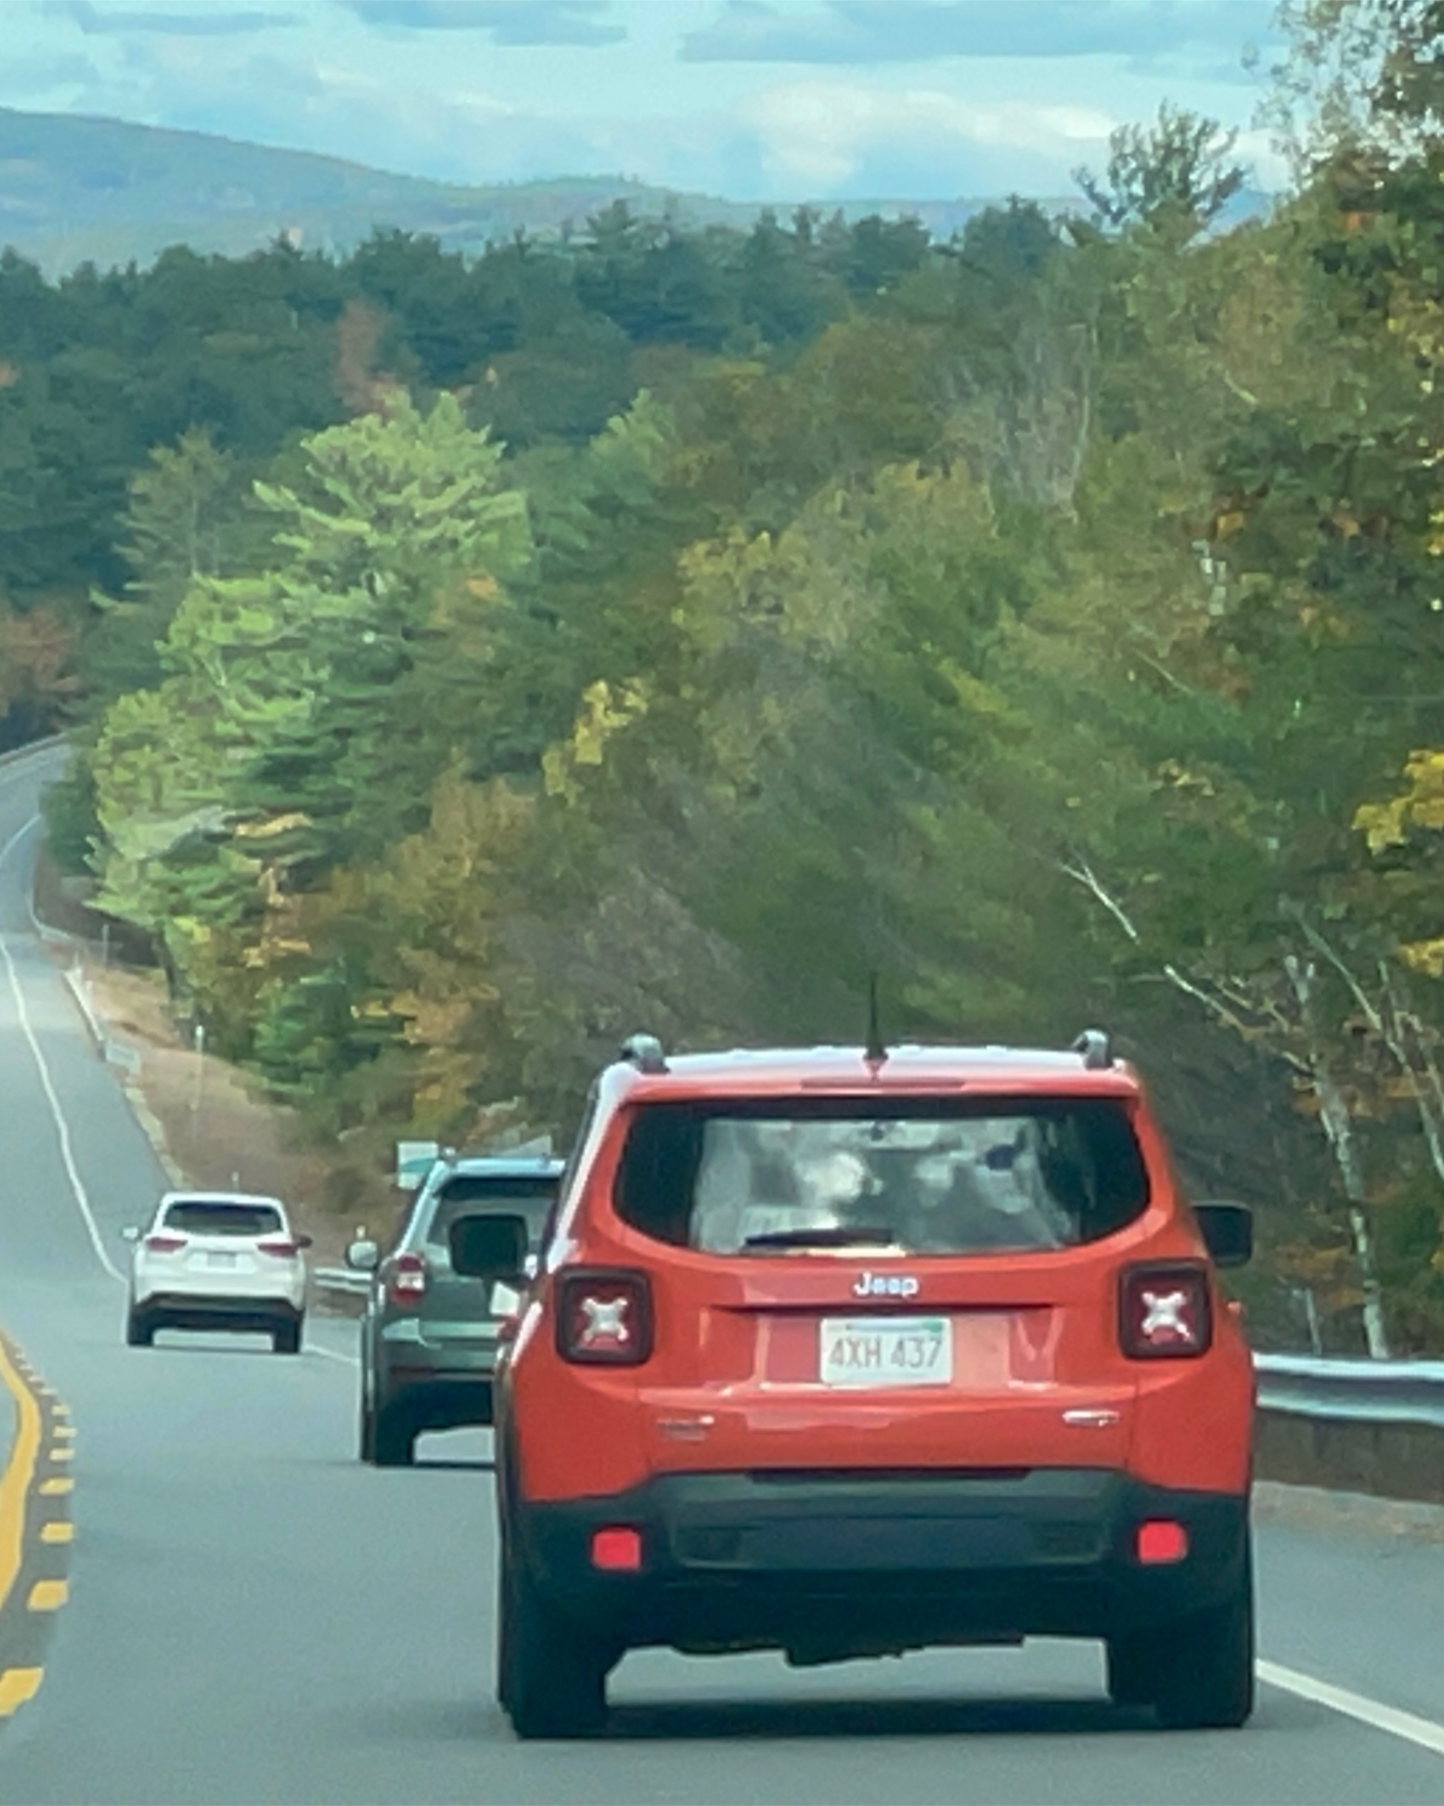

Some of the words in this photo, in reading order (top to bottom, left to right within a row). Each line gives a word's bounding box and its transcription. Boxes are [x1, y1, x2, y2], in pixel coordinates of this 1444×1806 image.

[854, 1271, 919, 1298] Jeep
[828, 1336, 882, 1368] 4XH
[890, 1336, 942, 1368] 437
